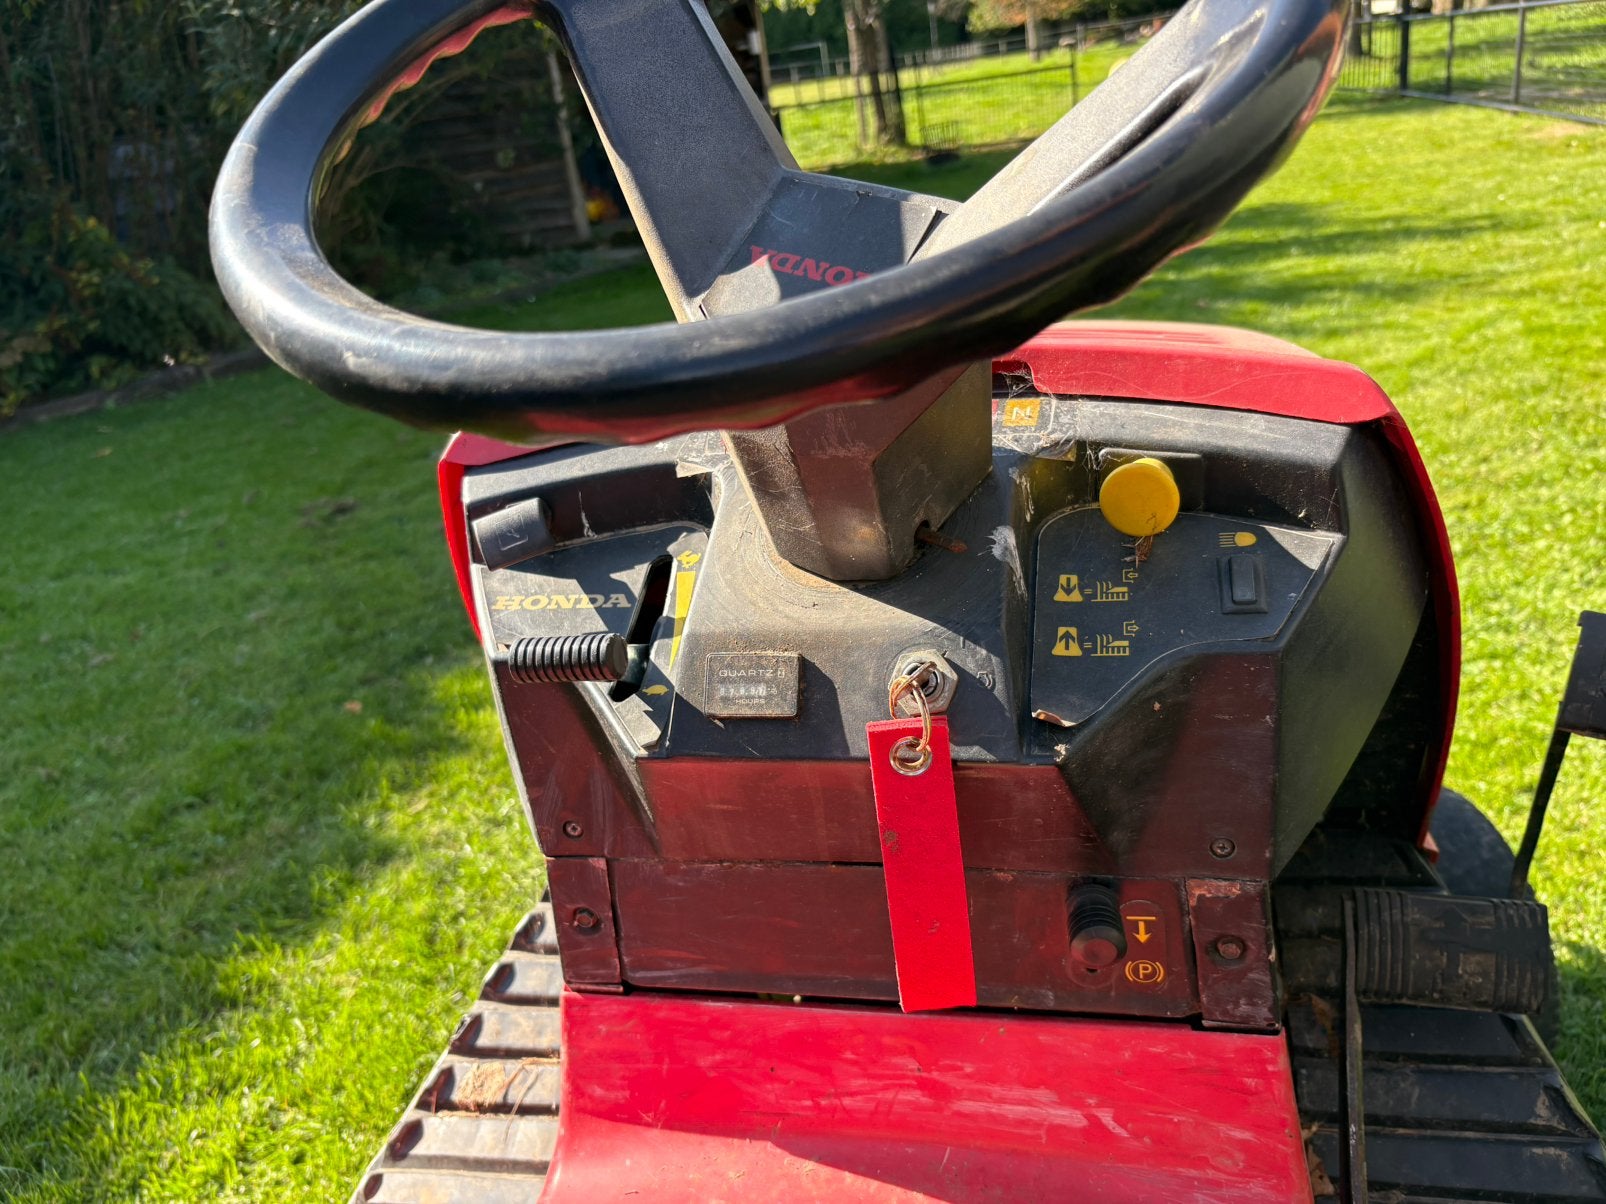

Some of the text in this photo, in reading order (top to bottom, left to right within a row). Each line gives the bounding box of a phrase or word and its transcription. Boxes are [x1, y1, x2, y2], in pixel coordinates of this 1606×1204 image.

[750, 245, 873, 287] ONDA
[491, 593, 631, 610] HONDA
[1139, 963, 1152, 979] P
